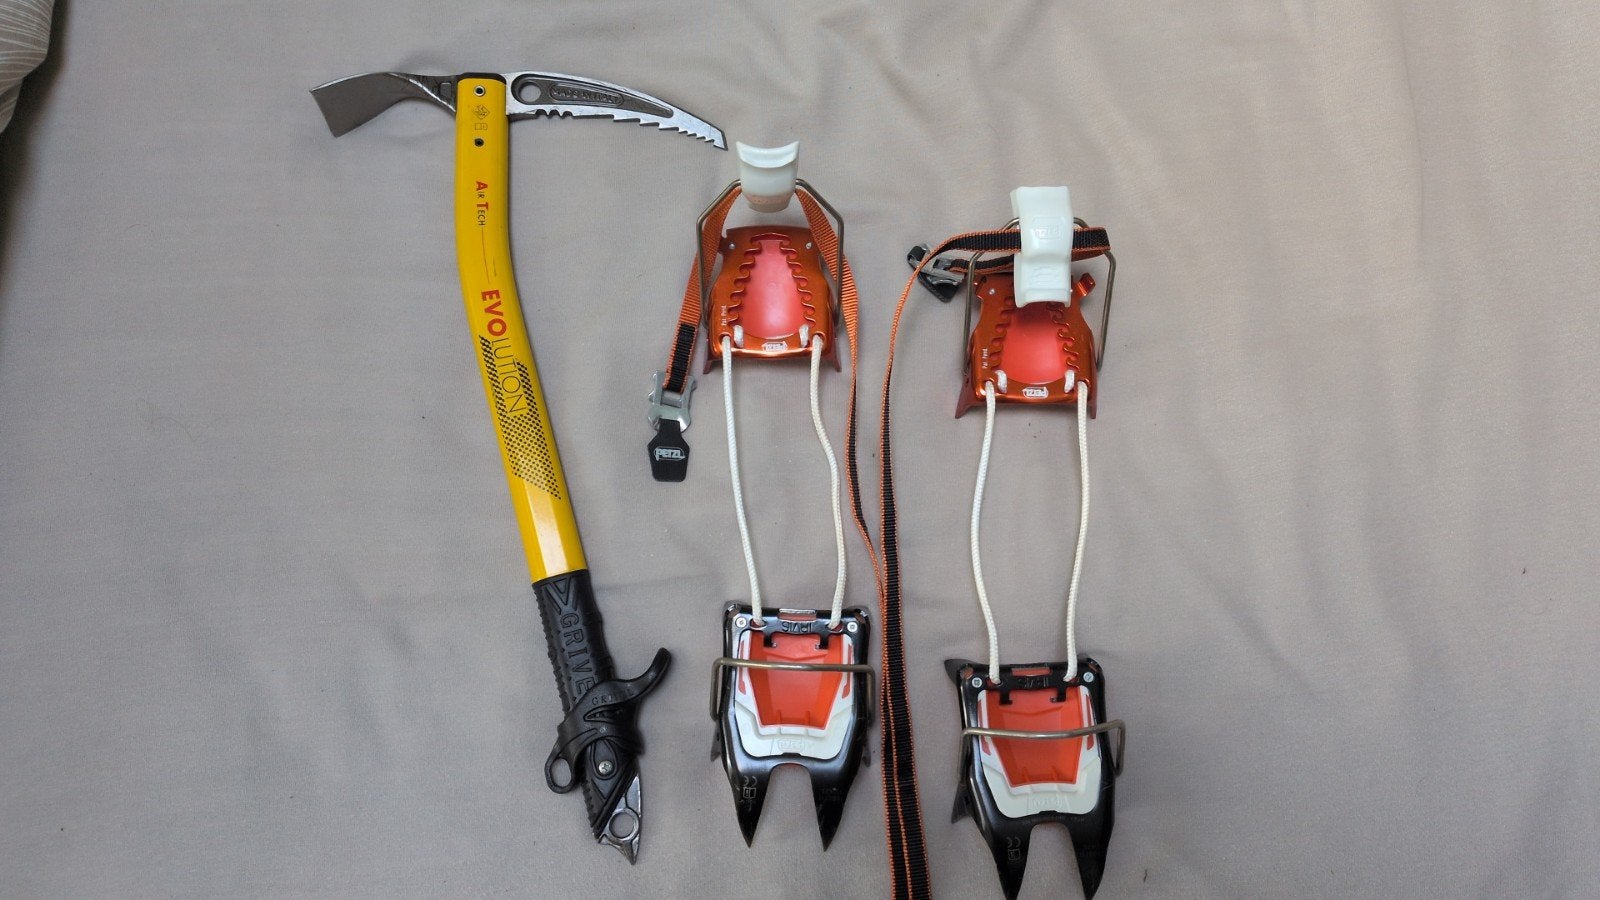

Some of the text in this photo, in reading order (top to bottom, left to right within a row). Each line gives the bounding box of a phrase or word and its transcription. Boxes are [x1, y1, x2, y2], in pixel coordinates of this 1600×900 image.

[480, 289, 527, 414] EVOLUTION
[654, 446, 686, 462] PETZL
[560, 612, 596, 695] GRIVE
